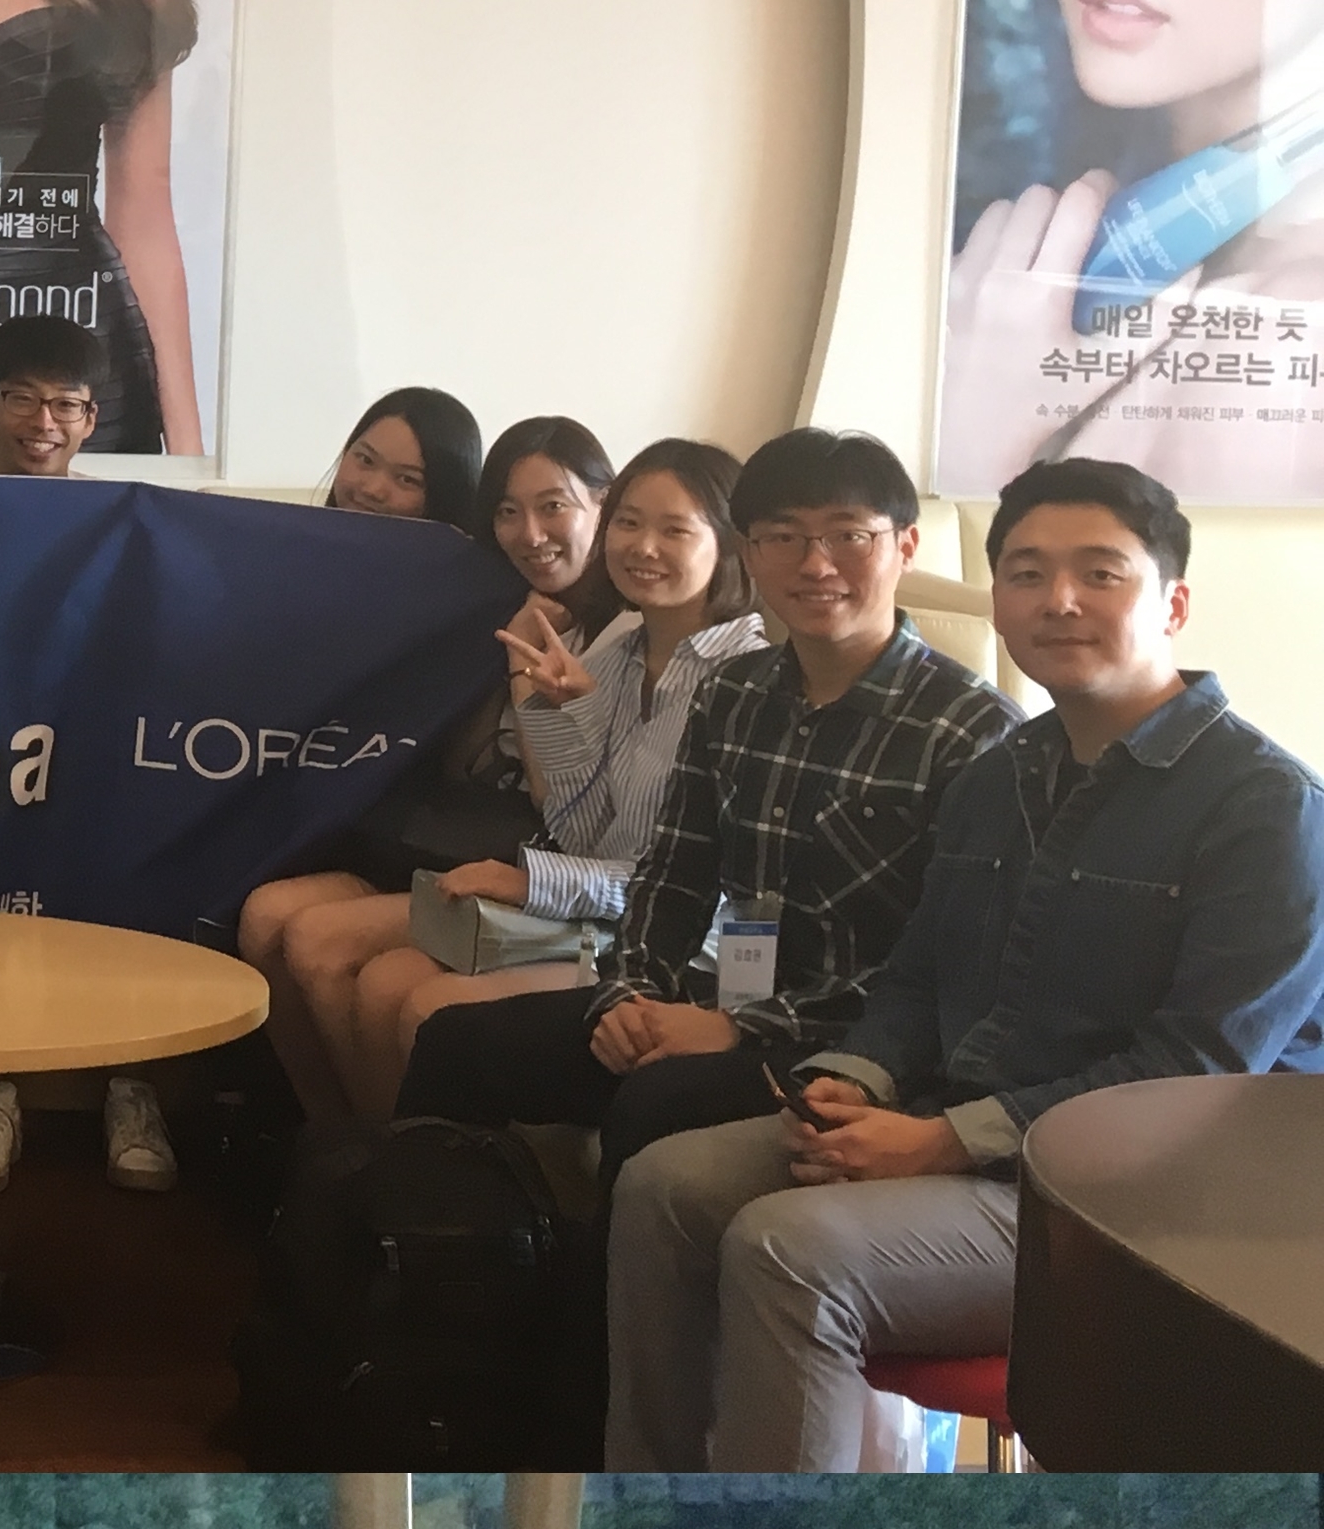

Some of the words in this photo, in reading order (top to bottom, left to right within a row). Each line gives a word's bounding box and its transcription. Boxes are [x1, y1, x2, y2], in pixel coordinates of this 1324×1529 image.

[39, 188, 79, 208] 전에
[1091, 303, 1153, 339] 매일
[1167, 303, 1264, 341] 온천한
[1274, 308, 1309, 342] 듯
[1039, 348, 1138, 384] 속부터
[1149, 350, 1275, 386] 차오르는
[1287, 353, 1324, 388] 피
[133, 716, 418, 777] L'ORÉA
